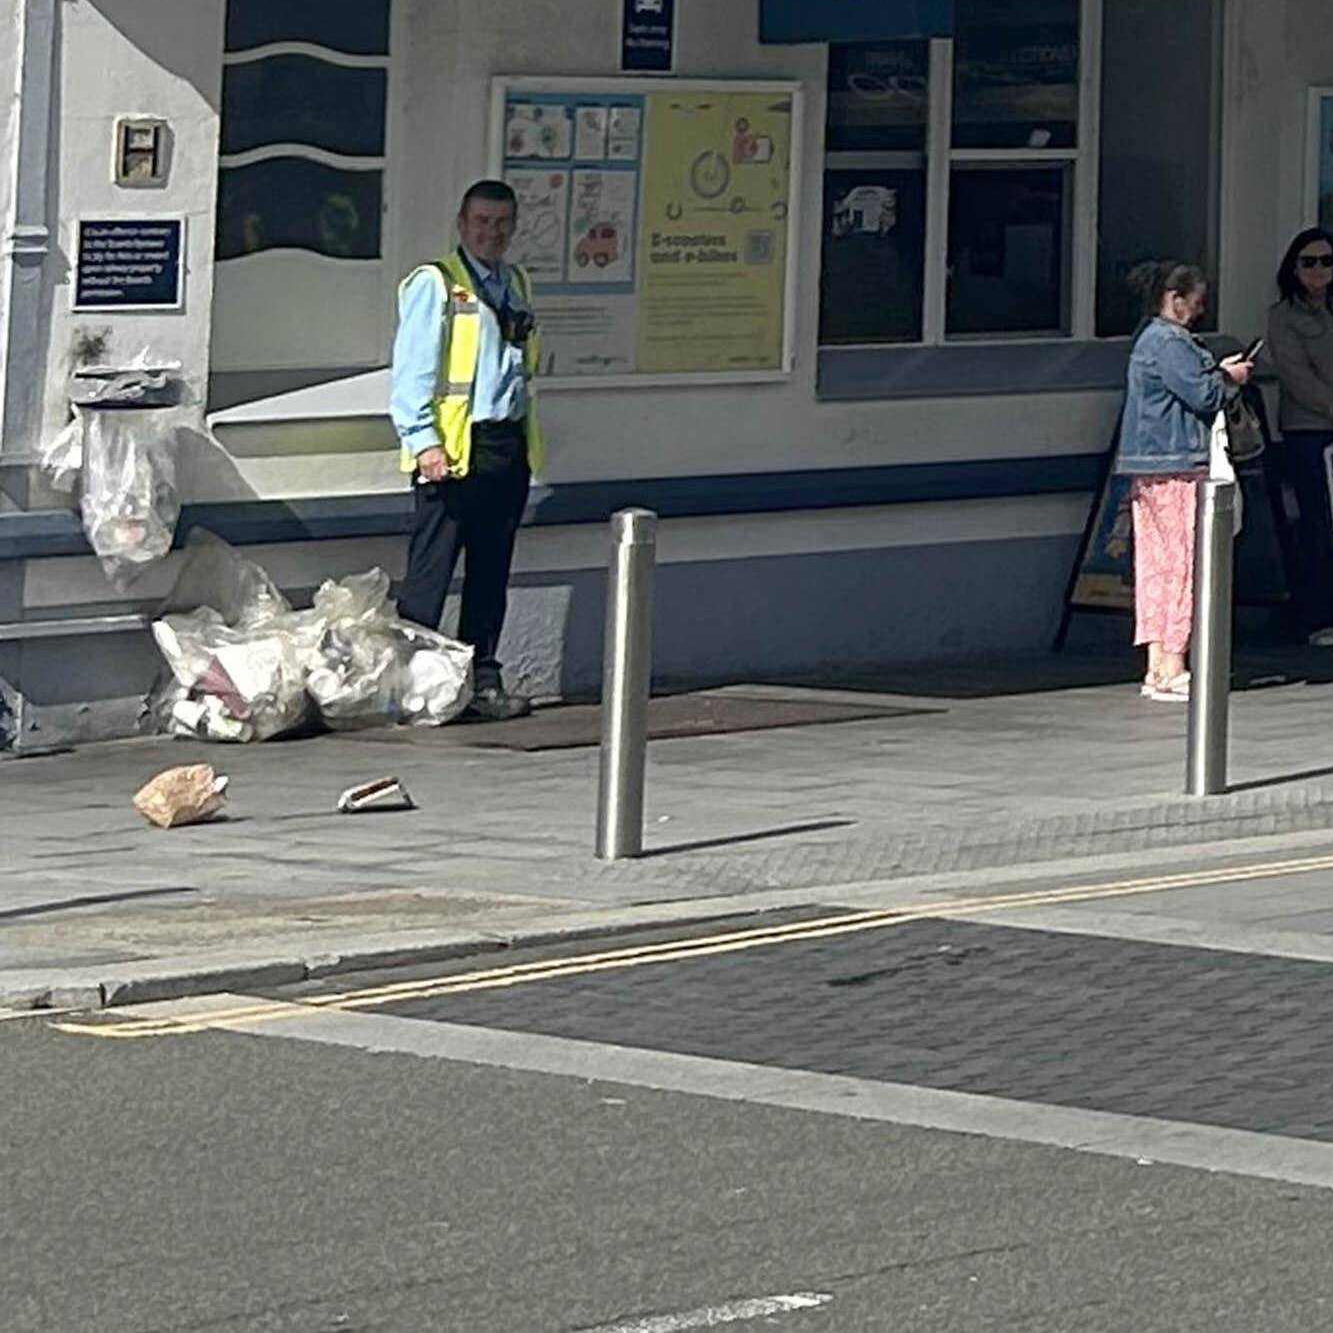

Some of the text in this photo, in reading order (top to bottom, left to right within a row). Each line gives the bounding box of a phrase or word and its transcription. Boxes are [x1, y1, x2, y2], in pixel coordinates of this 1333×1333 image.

[651, 232, 726, 247] E-scooters
[650, 249, 738, 263] and e-bikes
